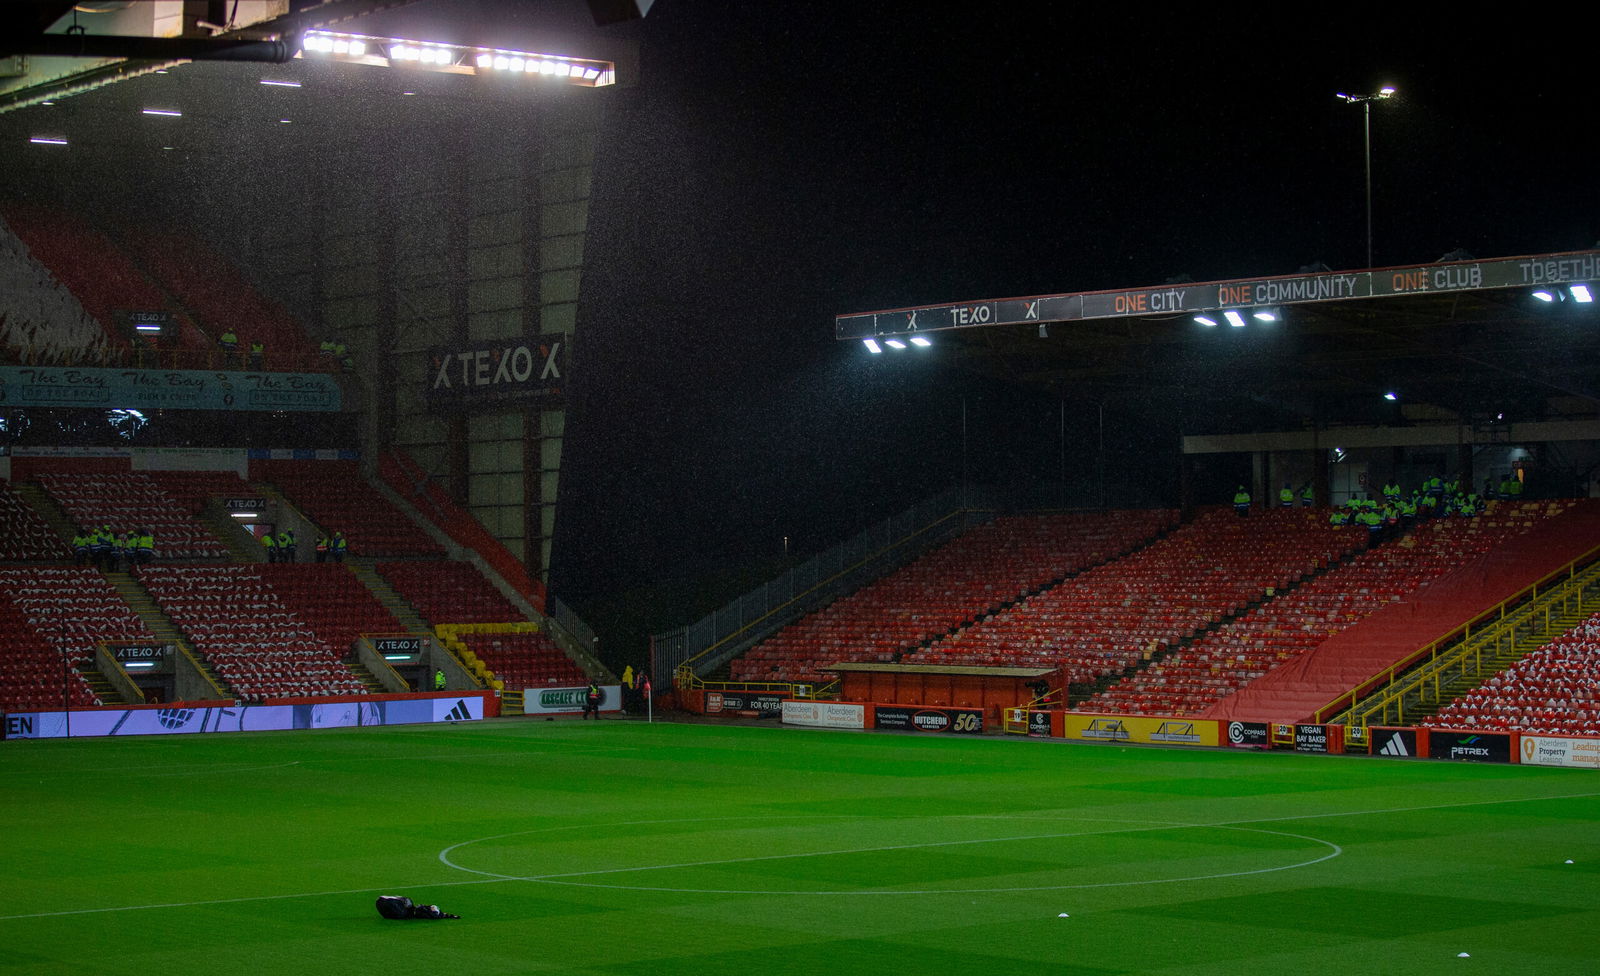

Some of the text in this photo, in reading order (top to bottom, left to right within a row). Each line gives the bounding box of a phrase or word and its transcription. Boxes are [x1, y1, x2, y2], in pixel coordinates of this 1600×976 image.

[1392, 268, 1482, 291] ONE CLUB
[1219, 277, 1357, 304] ONE COMMUNITY
[1115, 291, 1186, 313] ONE CITY
[950, 305, 990, 325] TEXO
[458, 346, 533, 386] TEXO
[19, 369, 105, 391] The Bay
[122, 372, 205, 391] The Bay
[246, 375, 327, 394] The Bay
[233, 500, 257, 508] TEXO
[385, 641, 410, 649] TEXO
[127, 648, 153, 657] TEXO
[750, 701, 762, 709] FOR
[762, 701, 769, 709] 40
[784, 703, 812, 713] Aberdeen
[827, 706, 856, 716] Aberdeen
[914, 715, 948, 726] HUTCHEON
[953, 713, 977, 731] 50
[1300, 726, 1322, 734] VEGAN
[1296, 734, 1327, 744] BAY BAKER
[1539, 739, 1567, 747] Aberdeen
[1451, 746, 1489, 759] PETREX
[1539, 748, 1565, 757] Property
[1539, 755, 1562, 764] Leasing
